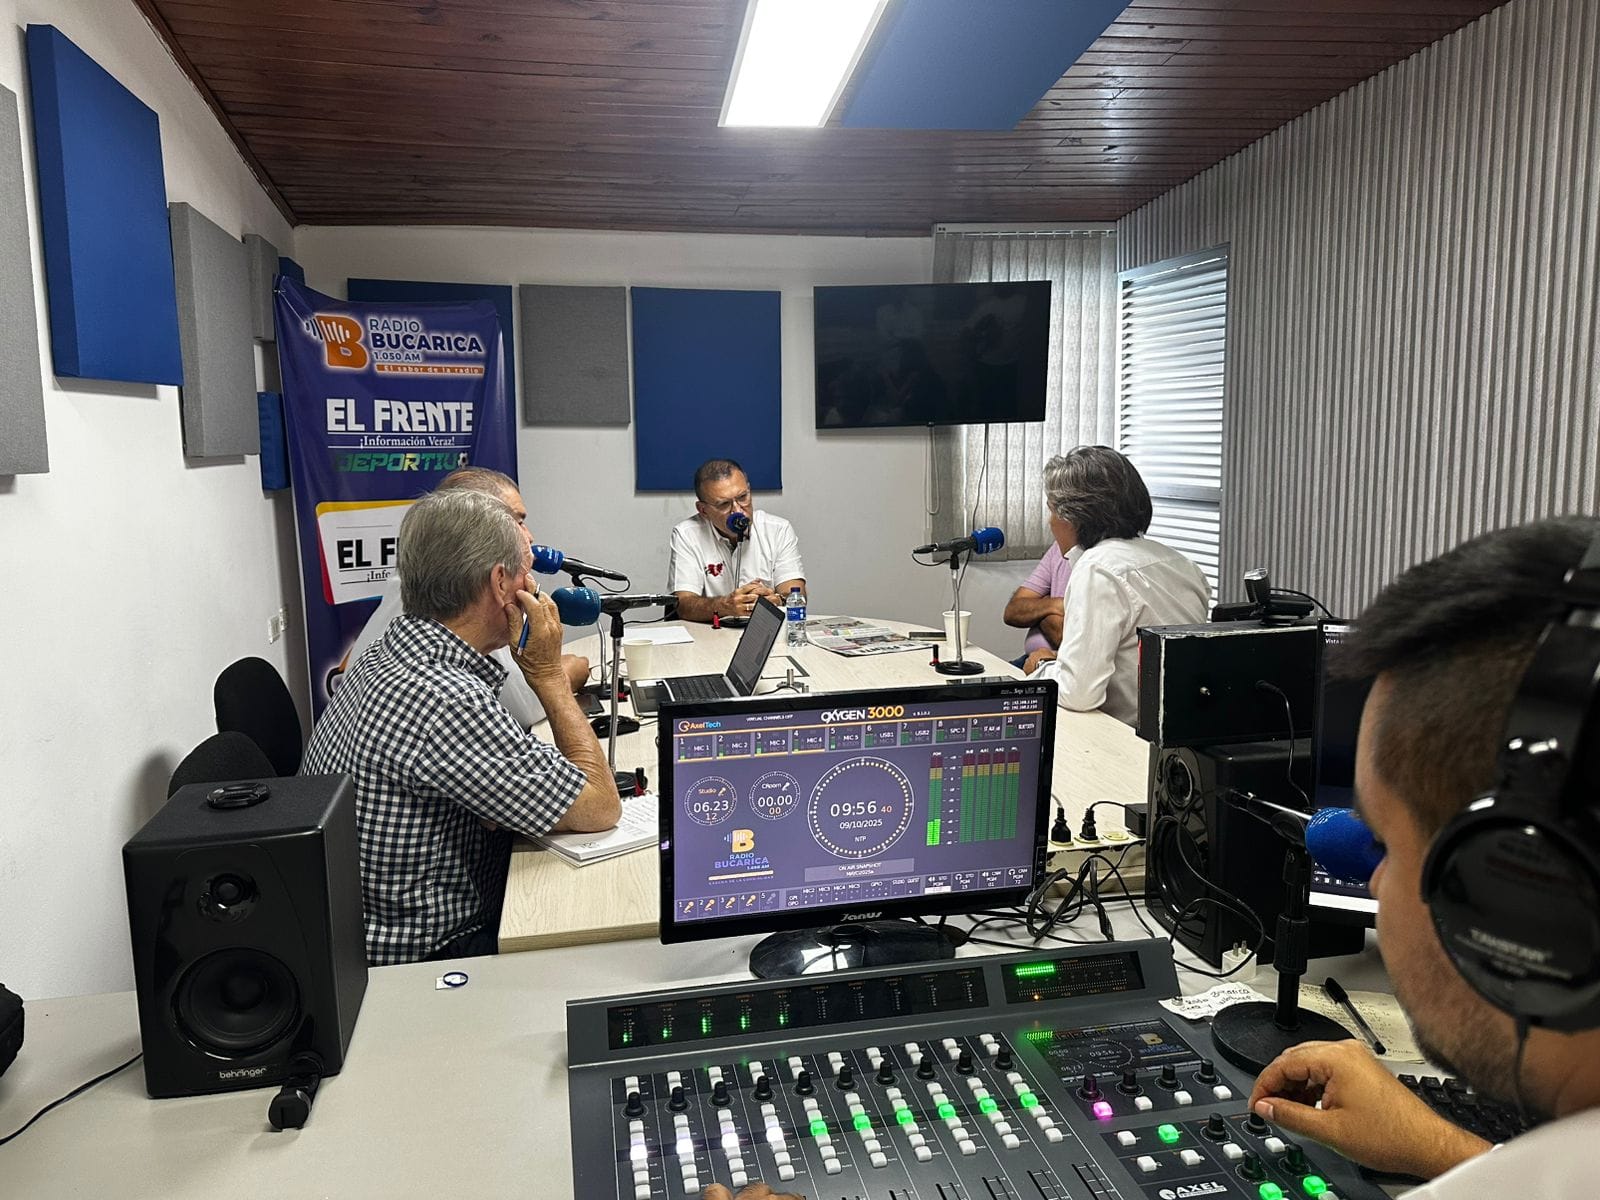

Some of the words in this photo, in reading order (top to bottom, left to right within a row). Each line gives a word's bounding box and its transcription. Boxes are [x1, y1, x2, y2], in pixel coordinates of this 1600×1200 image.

[369, 319, 420, 333] RADIO
[371, 332, 482, 352] BUCARICA
[374, 352, 402, 361] 1.050
[405, 353, 421, 361] AM
[326, 398, 366, 432] EL
[374, 399, 473, 432] FRENTE
[360, 436, 426, 449] ¡Información
[428, 436, 455, 446] Veraz!
[337, 539, 372, 569] EL
[821, 709, 866, 724] OXYGEN
[867, 705, 904, 719] 3000
[693, 800, 729, 813] 06.23
[758, 795, 793, 808] 00.00
[769, 807, 781, 815] 00
[830, 801, 877, 817] 09:56
[881, 805, 892, 813] 40
[705, 812, 718, 820] 12
[839, 818, 883, 829] 09/10/2025
[715, 856, 769, 869] BUCARICA
[729, 852, 755, 860] RADIO
[840, 912, 882, 921] Janus
[219, 1067, 267, 1079] behringer
[1176, 1181, 1222, 1196] AXEL
